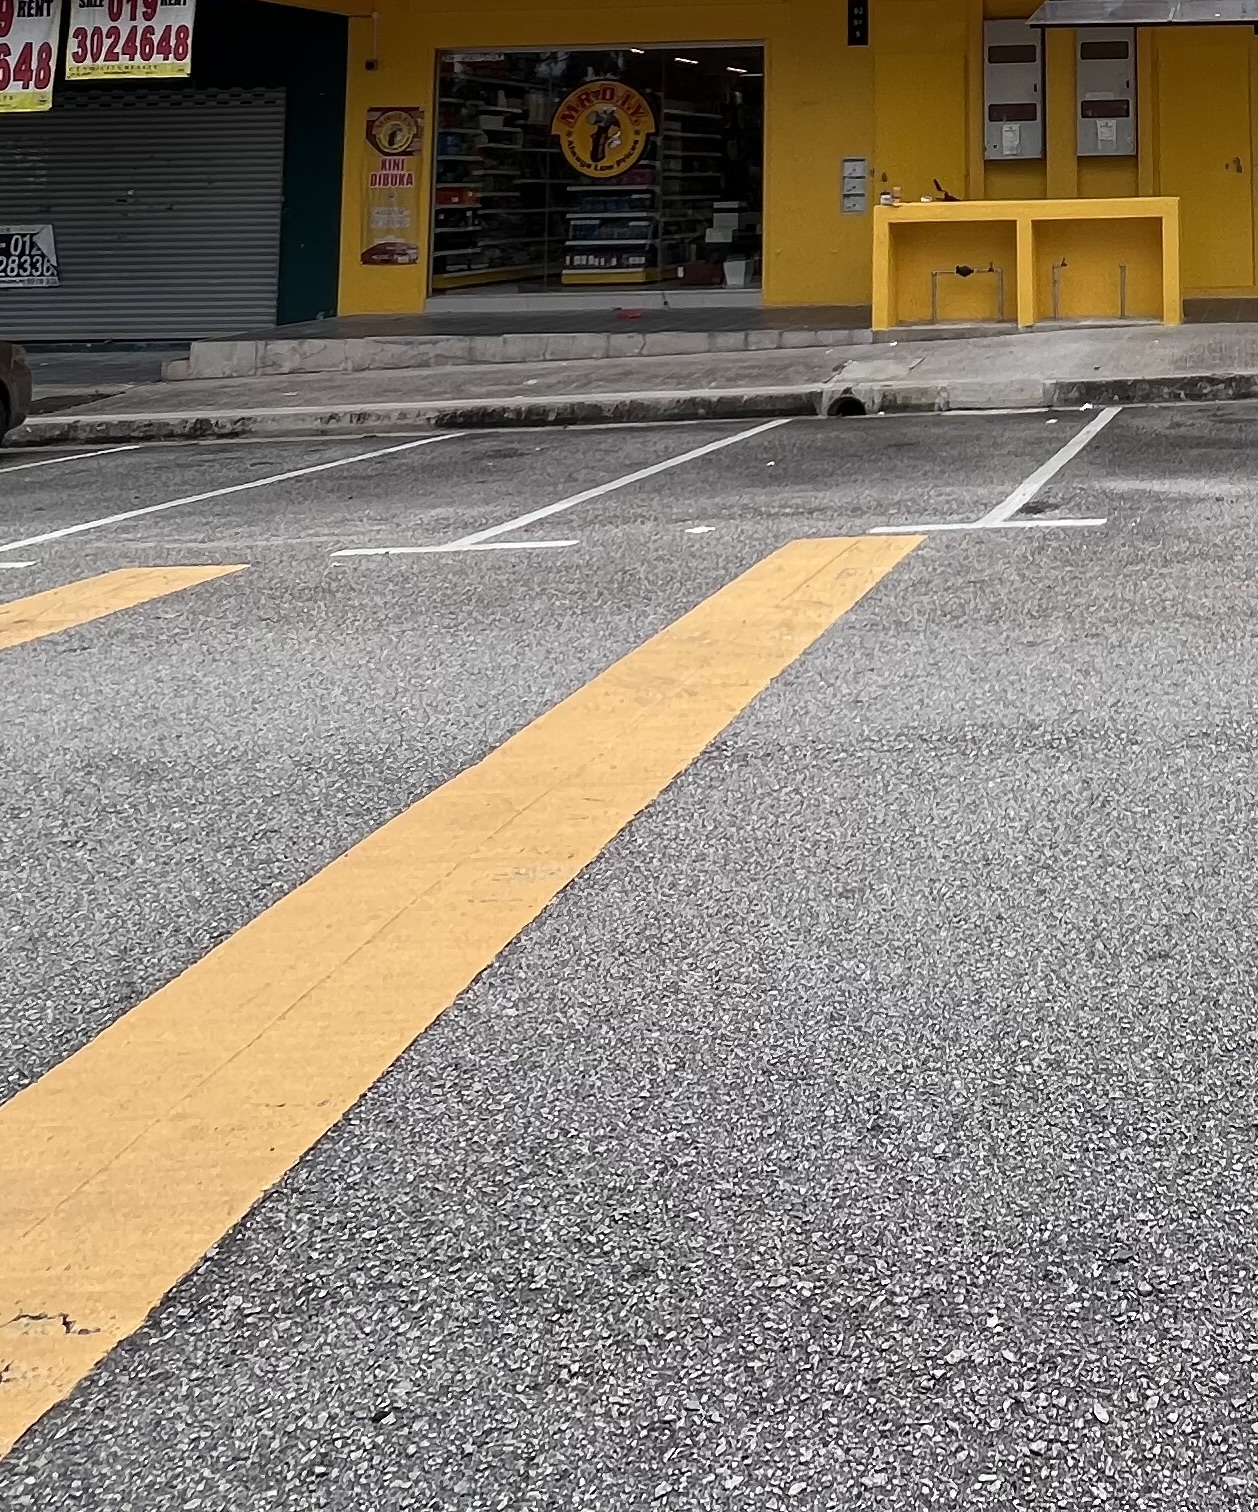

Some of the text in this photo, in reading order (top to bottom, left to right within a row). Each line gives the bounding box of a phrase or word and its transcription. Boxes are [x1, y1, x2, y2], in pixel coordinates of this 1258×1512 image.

[17, 0, 54, 18] RENT
[71, 24, 190, 64] 3024648
[380, 157, 405, 171] KINI
[370, 172, 413, 187] DIBUKA
